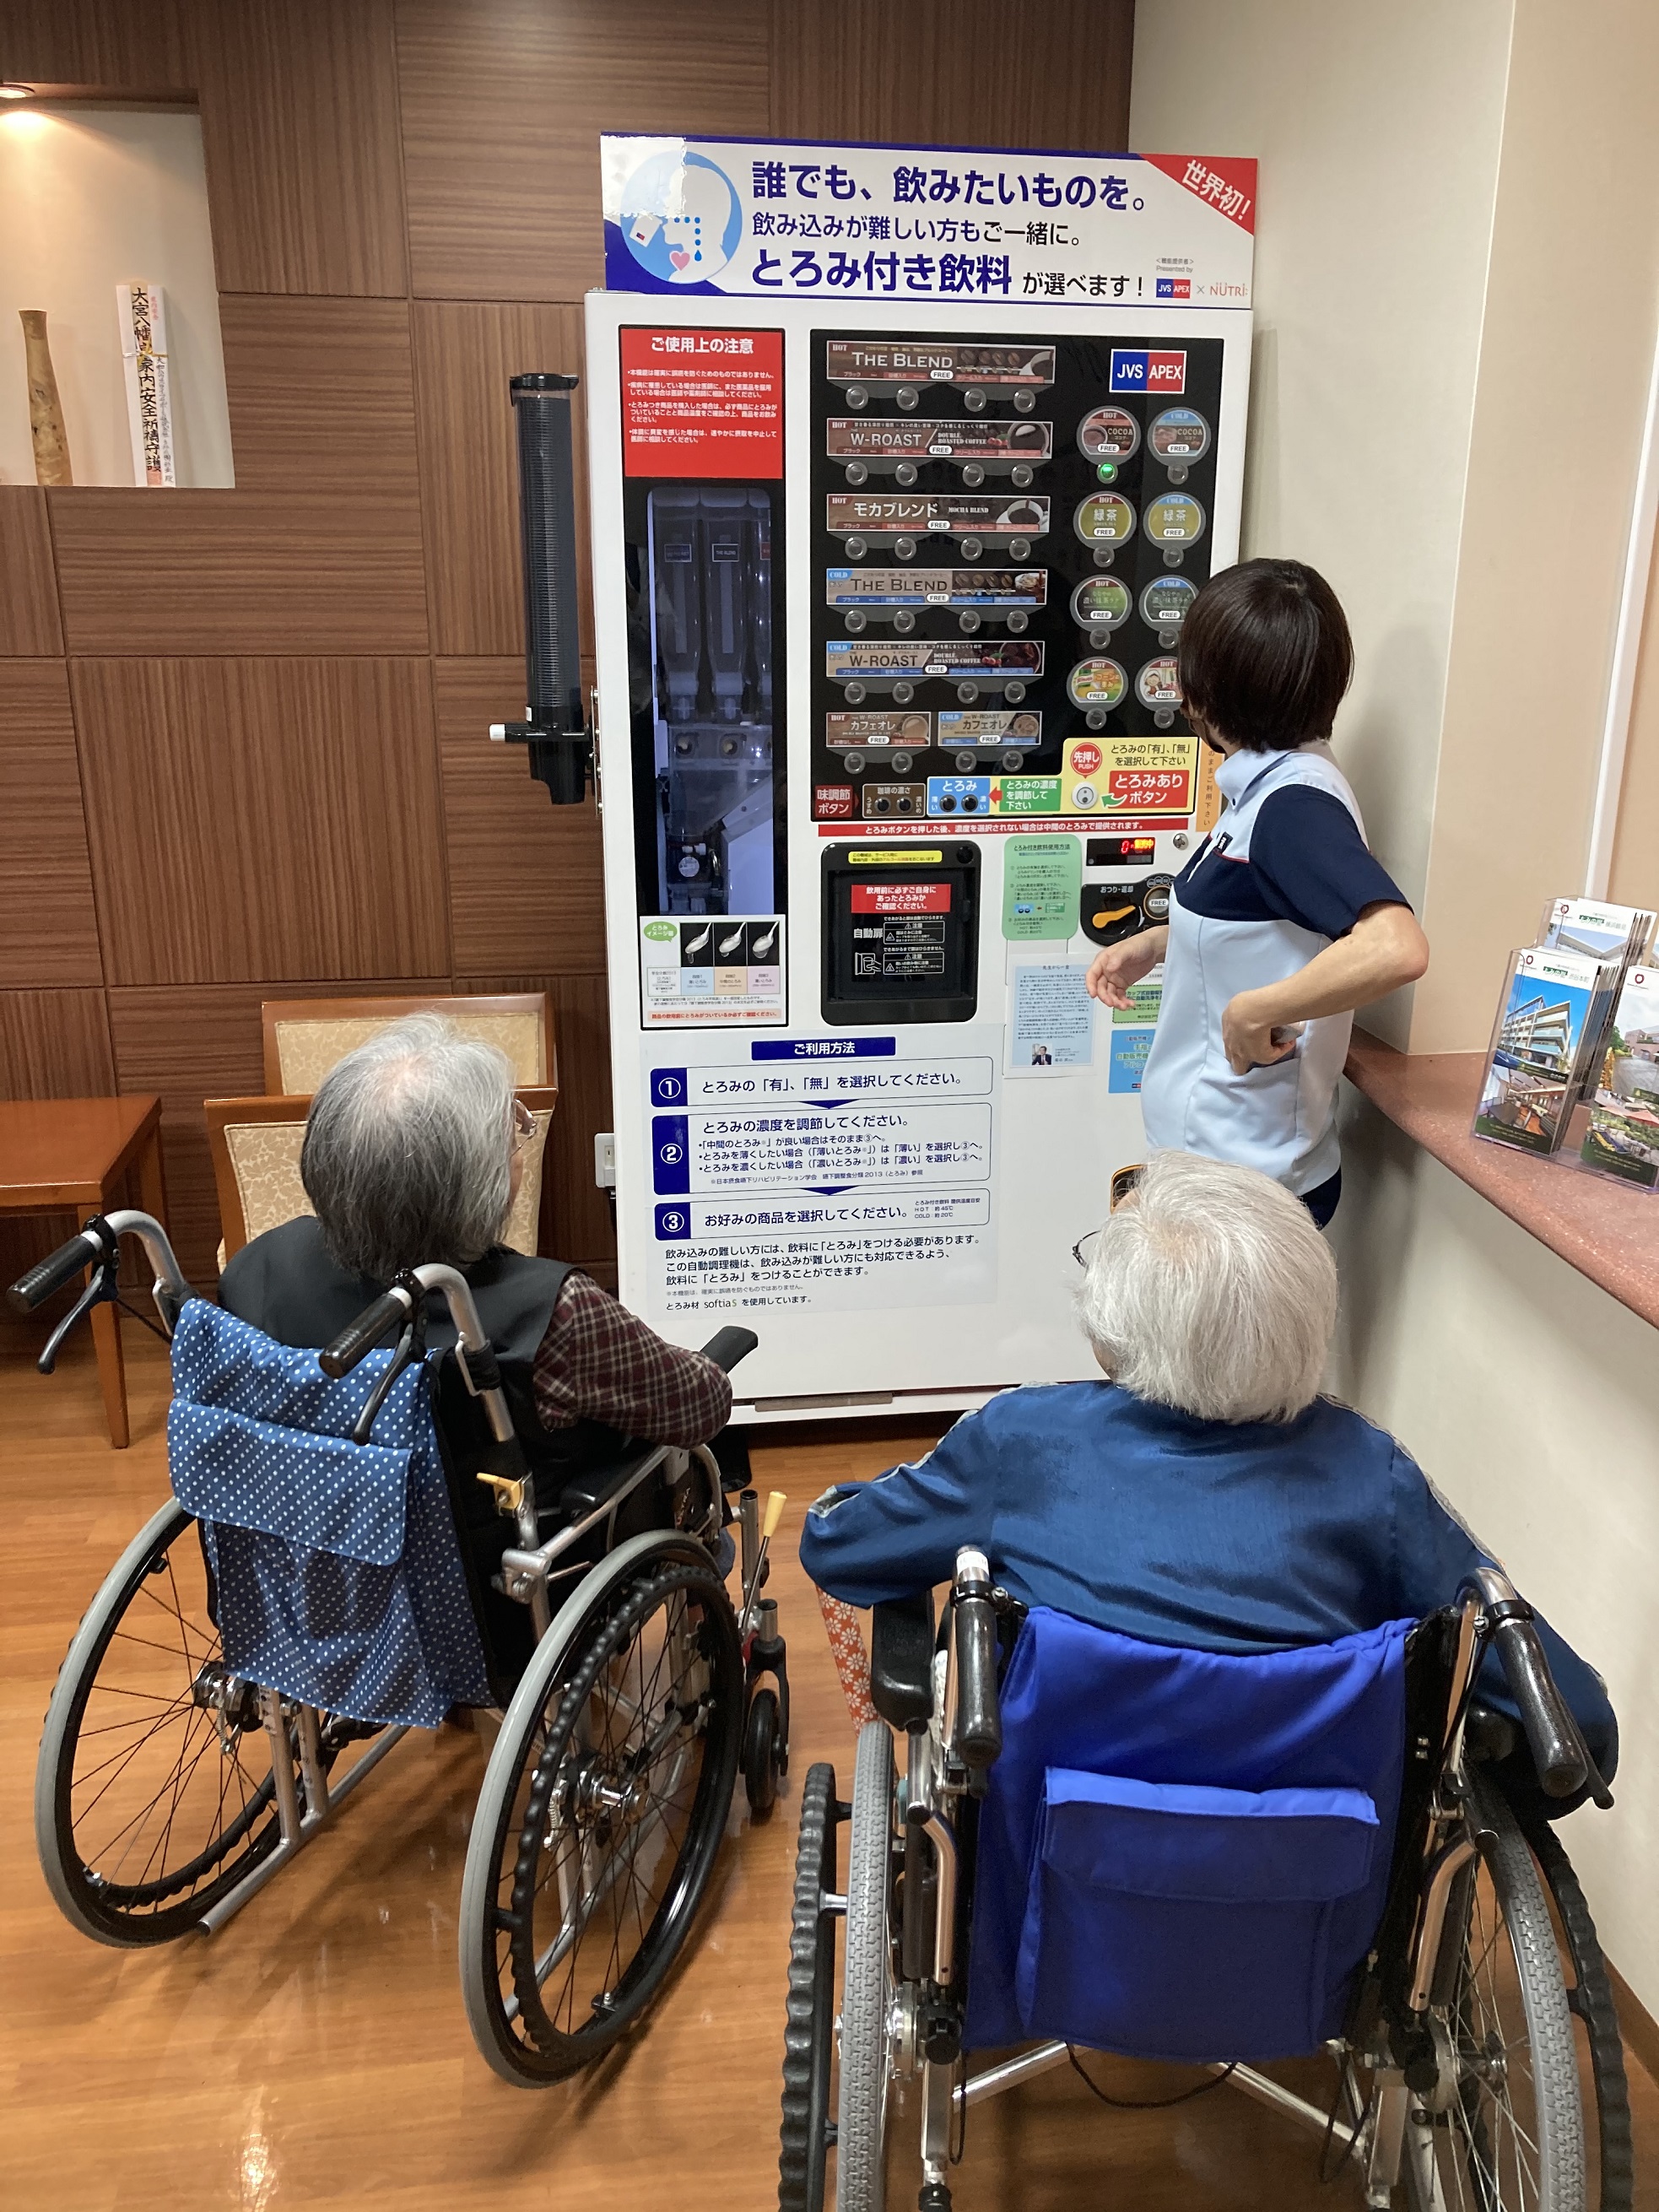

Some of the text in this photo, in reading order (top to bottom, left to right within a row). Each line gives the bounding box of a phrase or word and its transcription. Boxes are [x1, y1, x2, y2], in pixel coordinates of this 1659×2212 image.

[753, 161, 1144, 211] 誰でも、飲みたいものを。
[753, 212, 1079, 246] 飲み込みが難しい方もご一緒に。
[753, 249, 1012, 295] とろみ付き飲料
[1158, 284, 1190, 293] JVS APEX
[651, 337, 754, 354] ご使用上の注意
[851, 352, 953, 368] THE BLEND
[1117, 364, 1182, 380] JVS APEX
[851, 433, 922, 446] W-ROAST
[854, 502, 938, 517] モカブレンド
[1094, 509, 1186, 522] 緑茶 緑茶
[851, 579, 884, 591] THE
[891, 579, 947, 591] BLEND
[850, 655, 918, 666] W-ROAST
[851, 721, 895, 731] カフェオレ
[963, 720, 1007, 730] カフェオレ
[1073, 751, 1100, 763] 先押し
[1116, 757, 1186, 766] を選択して下さい
[943, 781, 977, 792] とろみ
[1006, 780, 1057, 789] とろみの濃度
[1115, 774, 1183, 788] とろみあり
[817, 789, 851, 801] 味調節
[1006, 791, 1047, 800] を調節して
[1129, 792, 1167, 803] ボタン
[819, 803, 849, 814] ボタン
[1006, 801, 1031, 809] 下さい
[1121, 841, 1129, 853] 0
[875, 902, 927, 911] ご確認ください。
[853, 928, 884, 938] 自動扉
[794, 1043, 856, 1055] ご利用方法
[703, 1115, 909, 1133] とろみの濃度を調節してください。
[705, 1207, 908, 1227] お好みの商品を選択してください。
[665, 1234, 980, 1259] 飲み込みの難しい方には、飲料に「とろみ」をつける必要があります。
[666, 1249, 951, 1273] この自動調理機は、飲み込みが難しい方にも対応できるよう、
[666, 1266, 870, 1286] 飲料に「とろみ」をつけることができます。
[666, 1301, 700, 1311] とろみ材
[742, 1295, 813, 1306] を使用しています。
